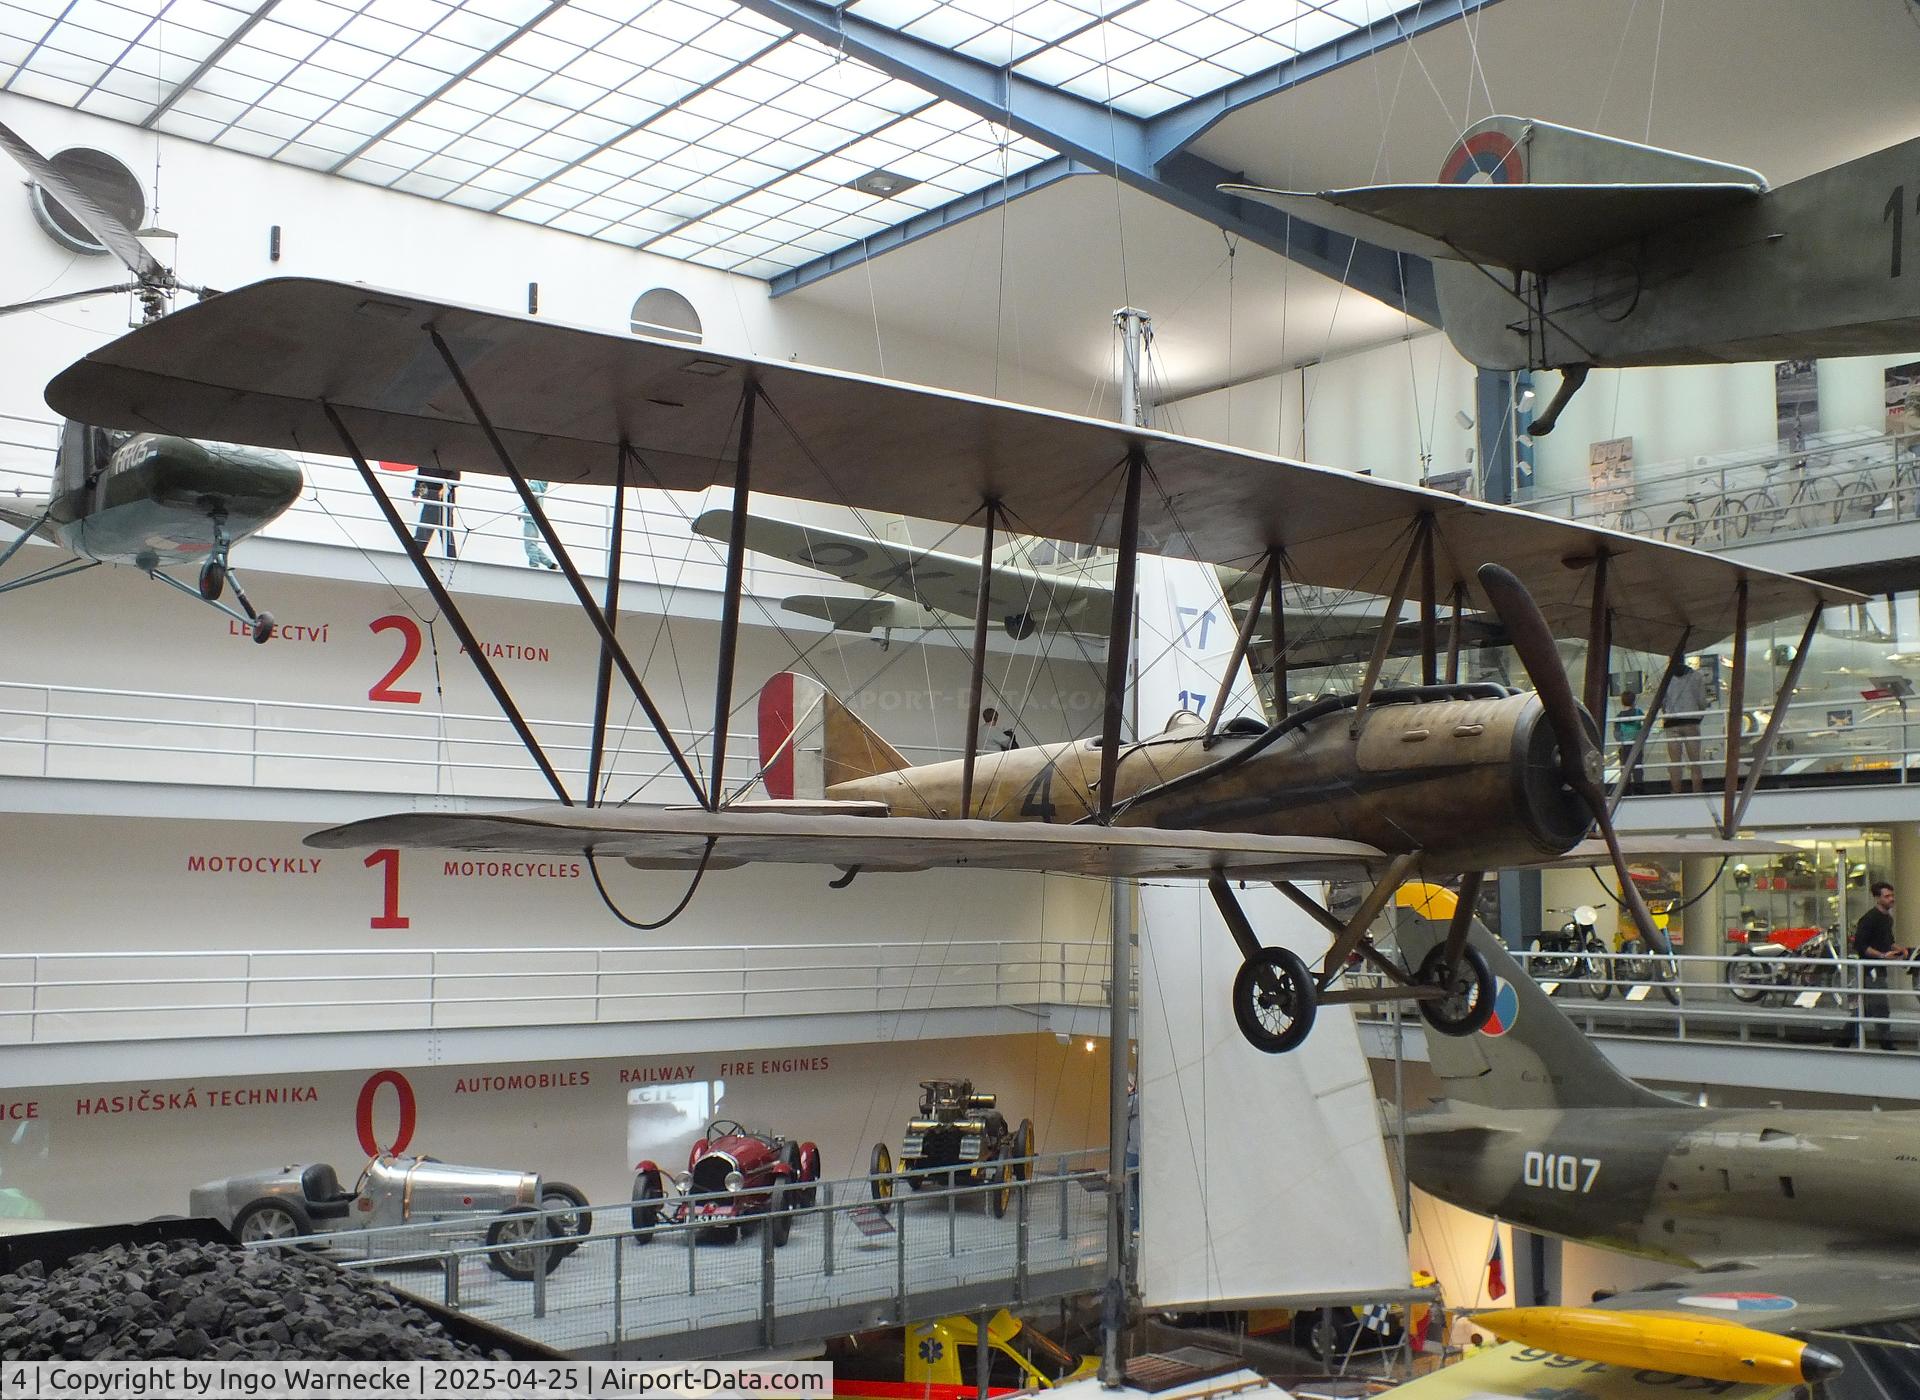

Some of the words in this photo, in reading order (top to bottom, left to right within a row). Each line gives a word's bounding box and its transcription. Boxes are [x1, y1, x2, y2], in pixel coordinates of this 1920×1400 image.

[1883, 184, 1920, 279] 1
[229, 620, 329, 643] LEECTVÍ
[368, 614, 422, 704] 2
[1018, 761, 1056, 824] 4
[187, 856, 322, 874] MOTOCYKLY
[443, 861, 581, 878] MOTORCYCLES
[363, 848, 410, 929] 1
[619, 1065, 697, 1083] RAILWAY
[720, 1060, 755, 1077] FIRE
[762, 1056, 830, 1074] ENGINES
[455, 1070, 591, 1094] AUTOMOBILES
[76, 1087, 198, 1116] HASIČSKÁ
[207, 1086, 319, 1108] TECHNIKA
[356, 1070, 417, 1159] 0
[1524, 1151, 1601, 1193] 0107
